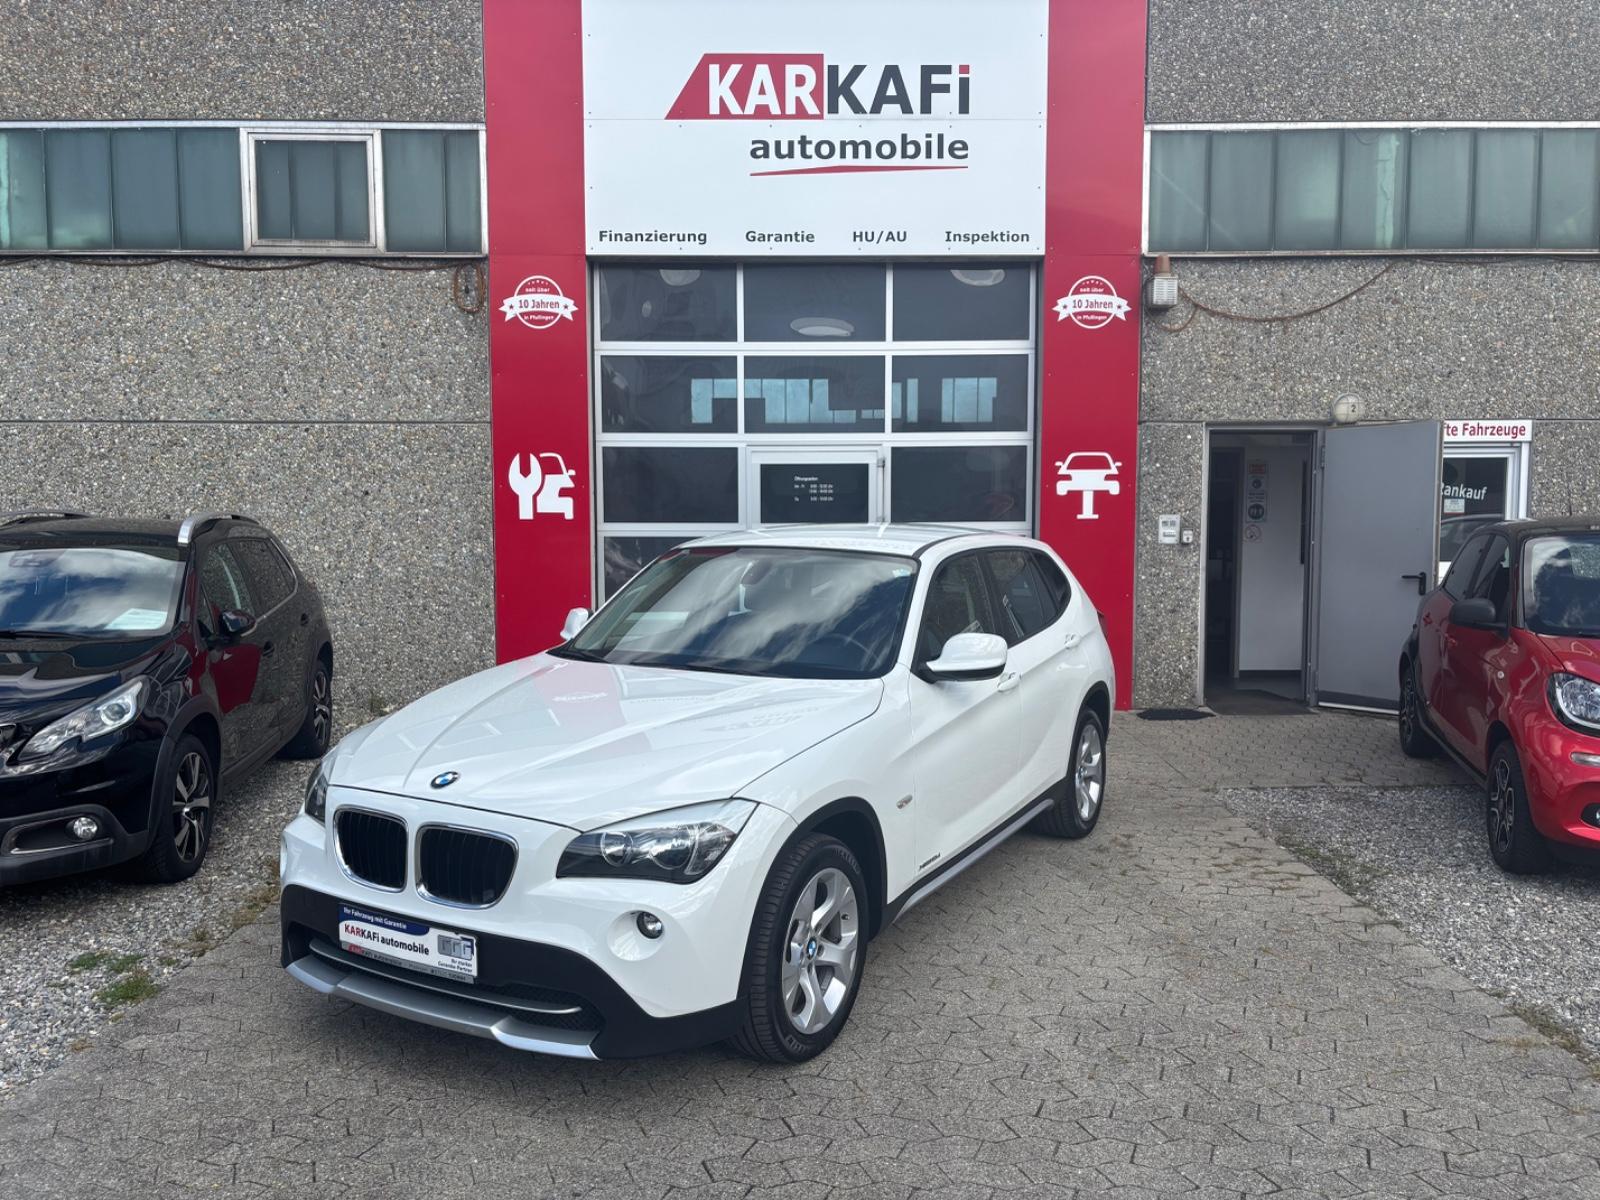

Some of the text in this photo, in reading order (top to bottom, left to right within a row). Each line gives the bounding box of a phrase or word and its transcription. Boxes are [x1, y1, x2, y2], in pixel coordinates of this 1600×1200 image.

[708, 64, 970, 115] KARKAFi
[749, 133, 969, 160] automobile
[599, 230, 1030, 246] Finanzierung Garantie HU/AU Inspektion
[518, 299, 560, 309] 10 Jahren
[1072, 299, 1114, 309] 10 Jahren
[1444, 422, 1527, 439] te Fahrzeuge
[351, 909, 374, 923] Fahrzeug
[384, 918, 407, 930] Garantie
[344, 923, 380, 944] KARKAFi
[380, 935, 430, 956] automobile
